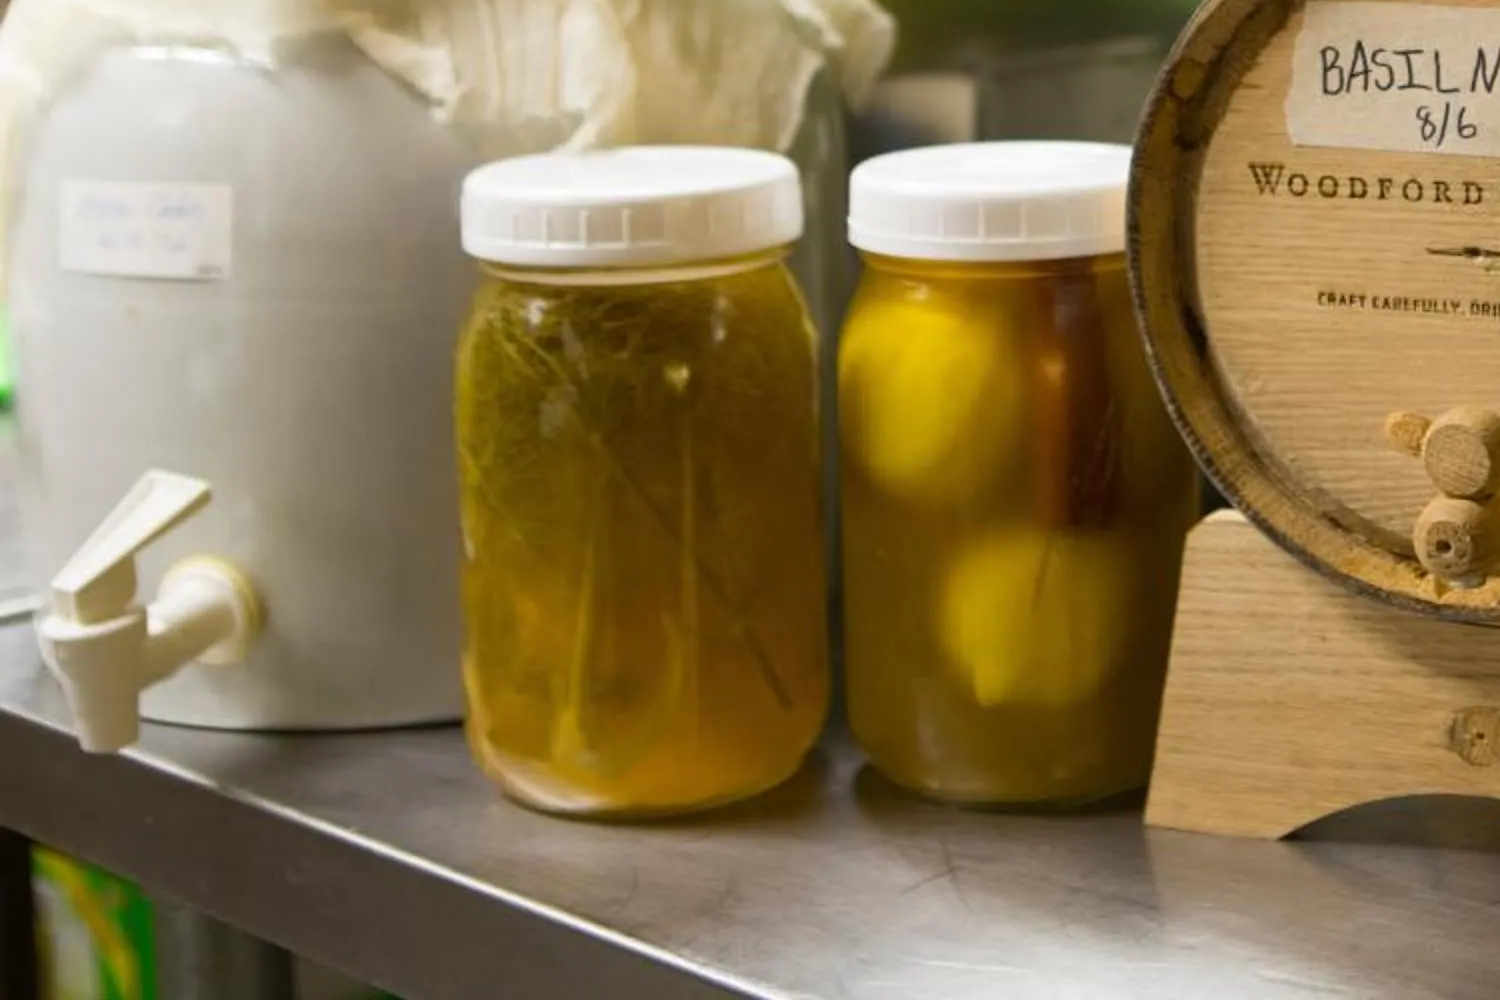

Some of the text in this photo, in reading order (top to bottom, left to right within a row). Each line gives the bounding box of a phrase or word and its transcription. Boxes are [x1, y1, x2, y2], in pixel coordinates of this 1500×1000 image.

[1320, 39, 1461, 96] BASIL
[1415, 101, 1478, 147] 8/6
[1248, 163, 1484, 206] WOODFORD
[1317, 291, 1366, 309] CRAFT
[1371, 295, 1466, 316] CAREFULLY.
